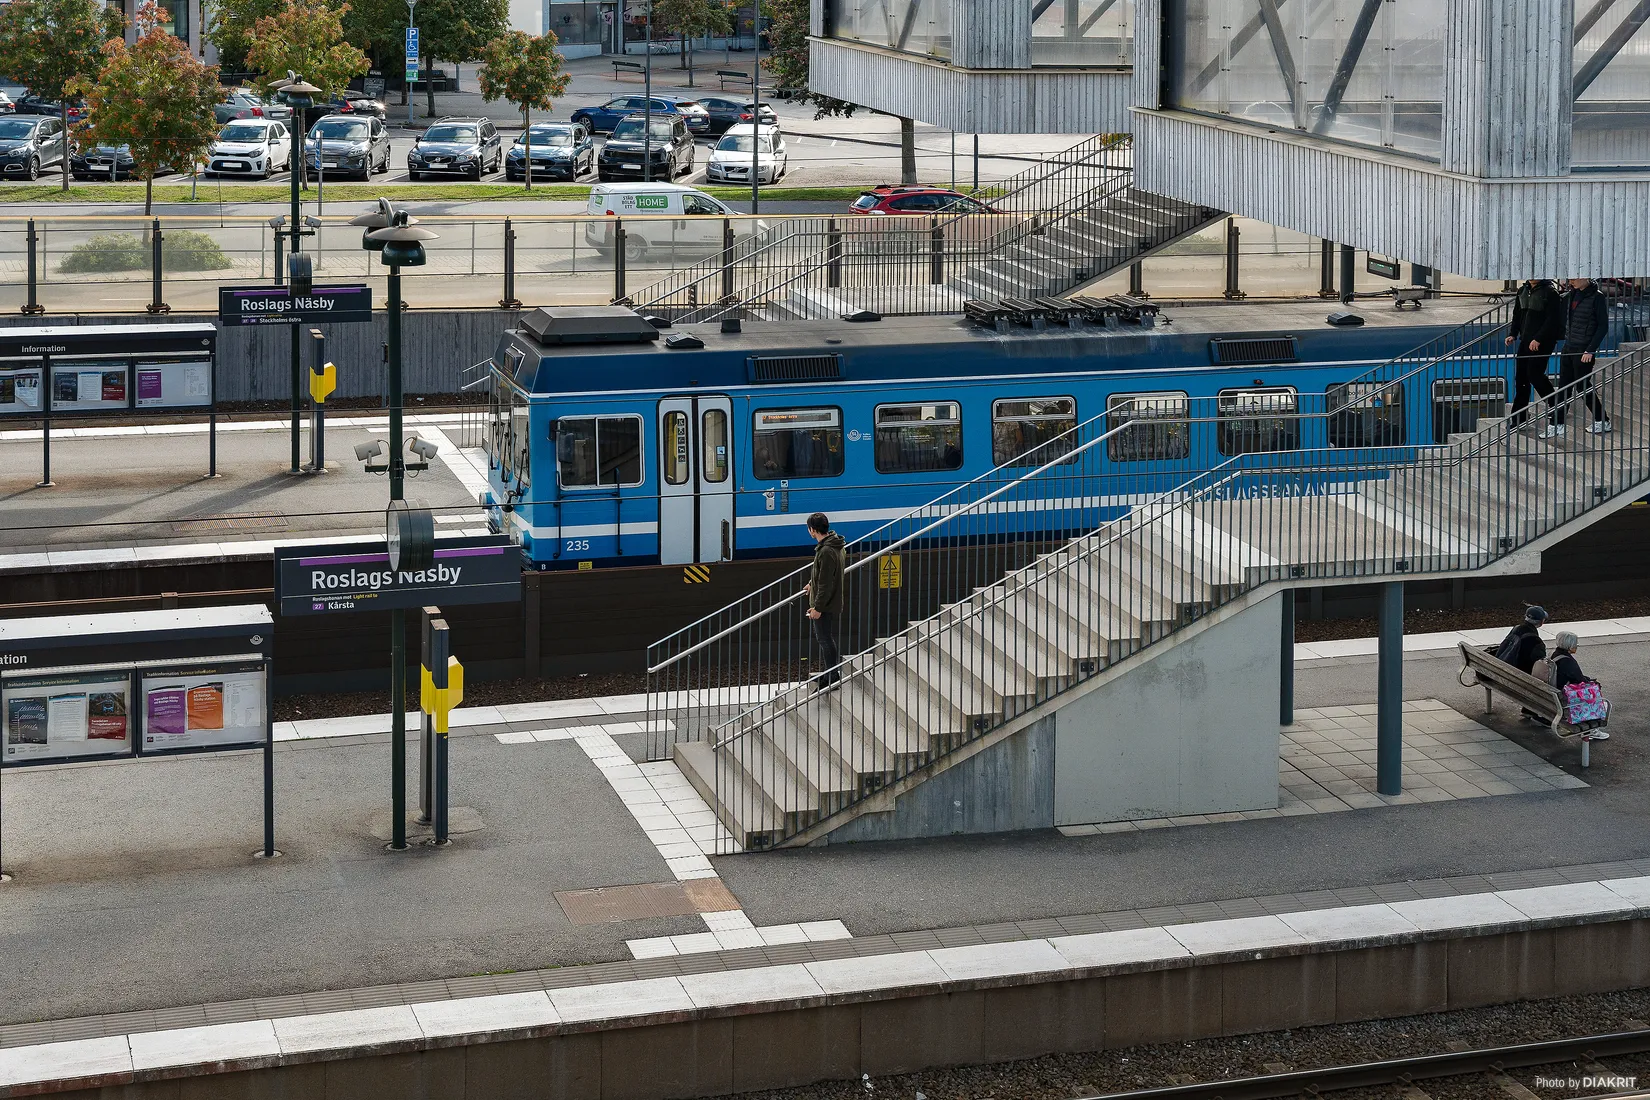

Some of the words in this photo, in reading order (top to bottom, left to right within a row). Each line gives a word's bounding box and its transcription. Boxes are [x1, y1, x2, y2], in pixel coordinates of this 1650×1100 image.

[409, 29, 416, 39] P
[639, 198, 665, 207] HOME
[241, 298, 292, 312] Roslags
[294, 296, 335, 311] Näsby
[21, 345, 66, 353] Information
[566, 540, 590, 551] 235
[311, 568, 393, 590] Roslags
[328, 601, 355, 610] Kårsta
